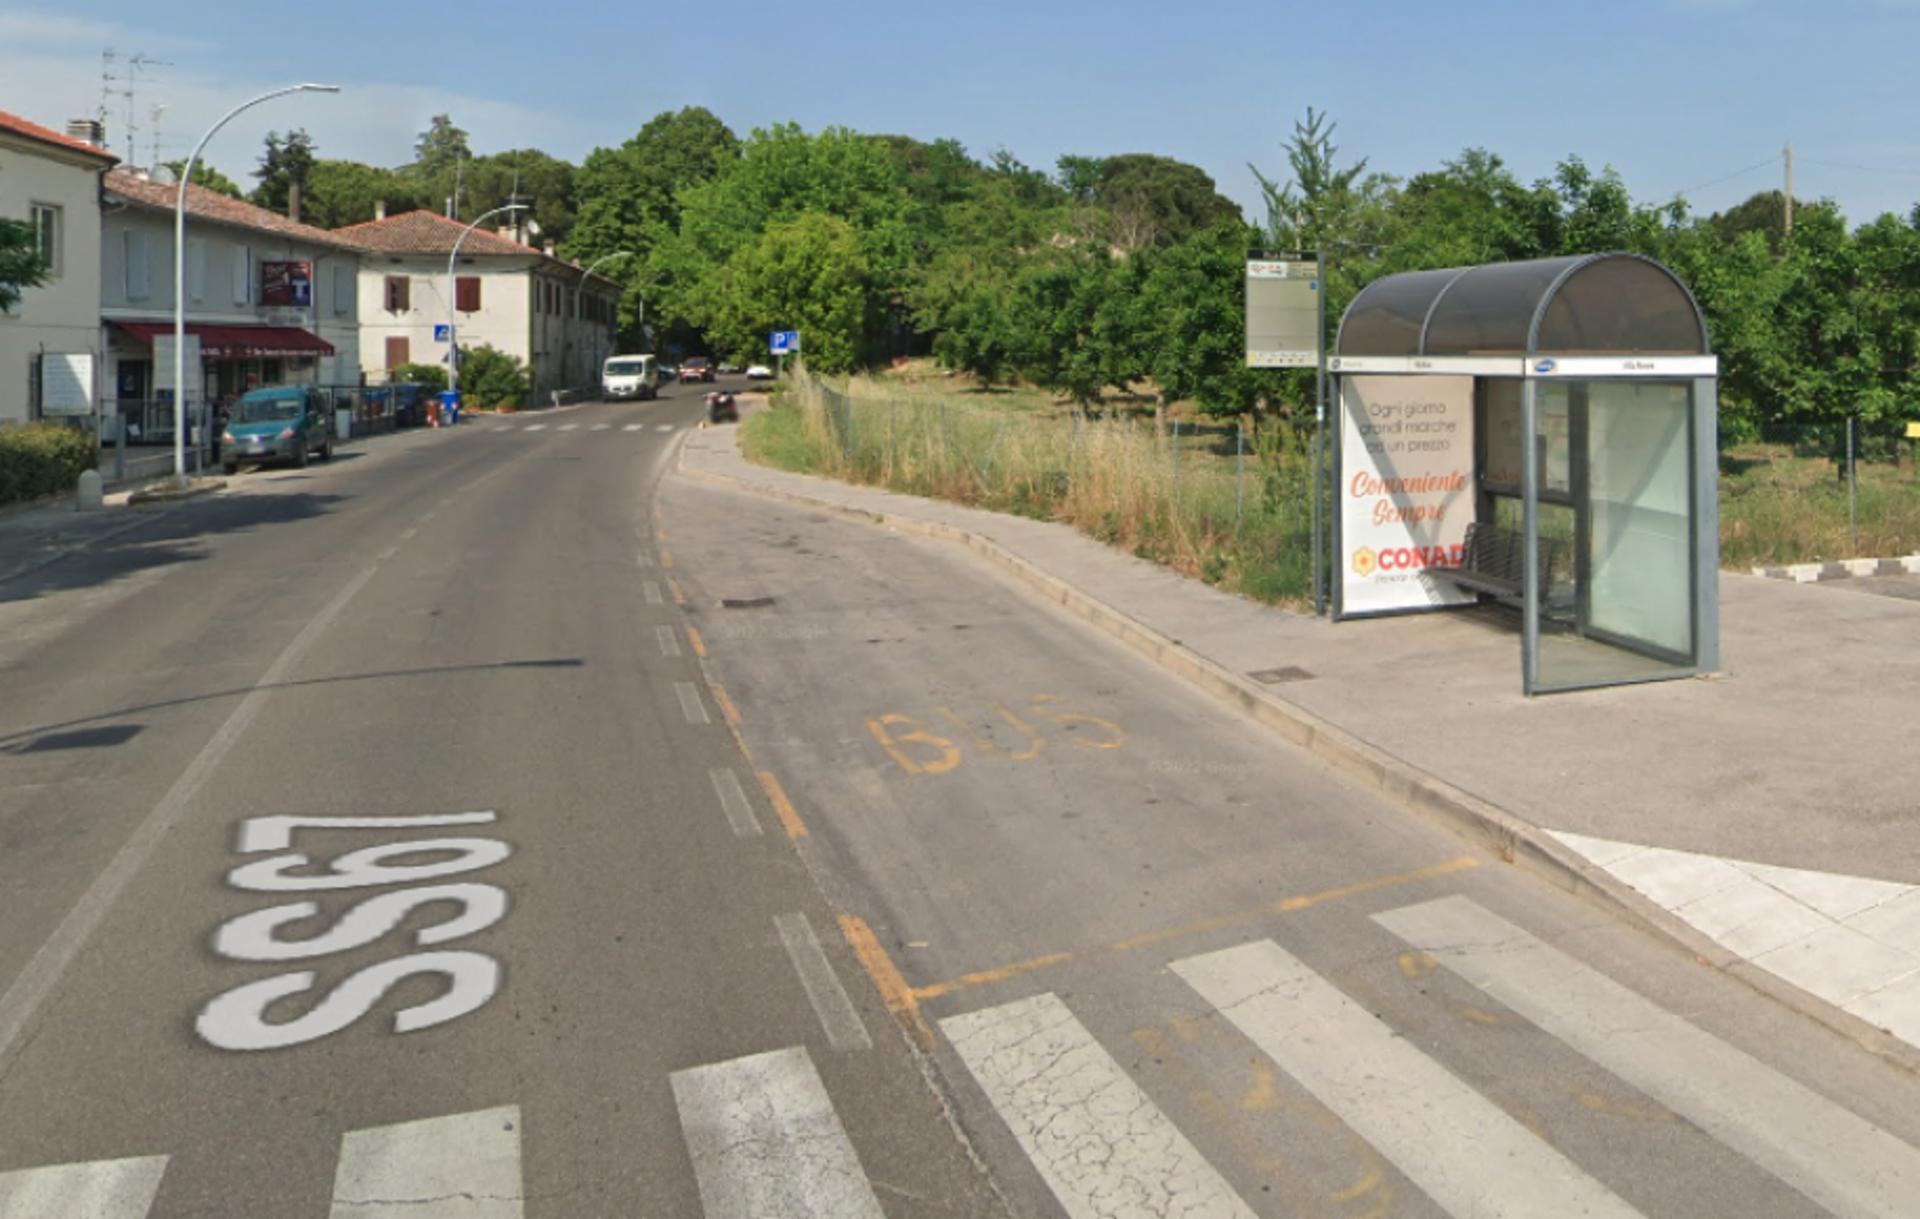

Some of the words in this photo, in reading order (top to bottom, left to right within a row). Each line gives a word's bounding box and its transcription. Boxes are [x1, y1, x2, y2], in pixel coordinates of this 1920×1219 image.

[774, 332, 786, 349] P
[1370, 402, 1402, 418] Ogni
[1405, 402, 1447, 418] giorno
[1360, 420, 1402, 436] grandi
[1405, 420, 1457, 433] marche
[1388, 442, 1405, 453] un
[1408, 440, 1450, 453] prezzo
[1350, 470, 1465, 498] Conveniente
[1372, 498, 1446, 528] Sempre
[866, 692, 1130, 774] BUS
[195, 810, 513, 1051] SS67
